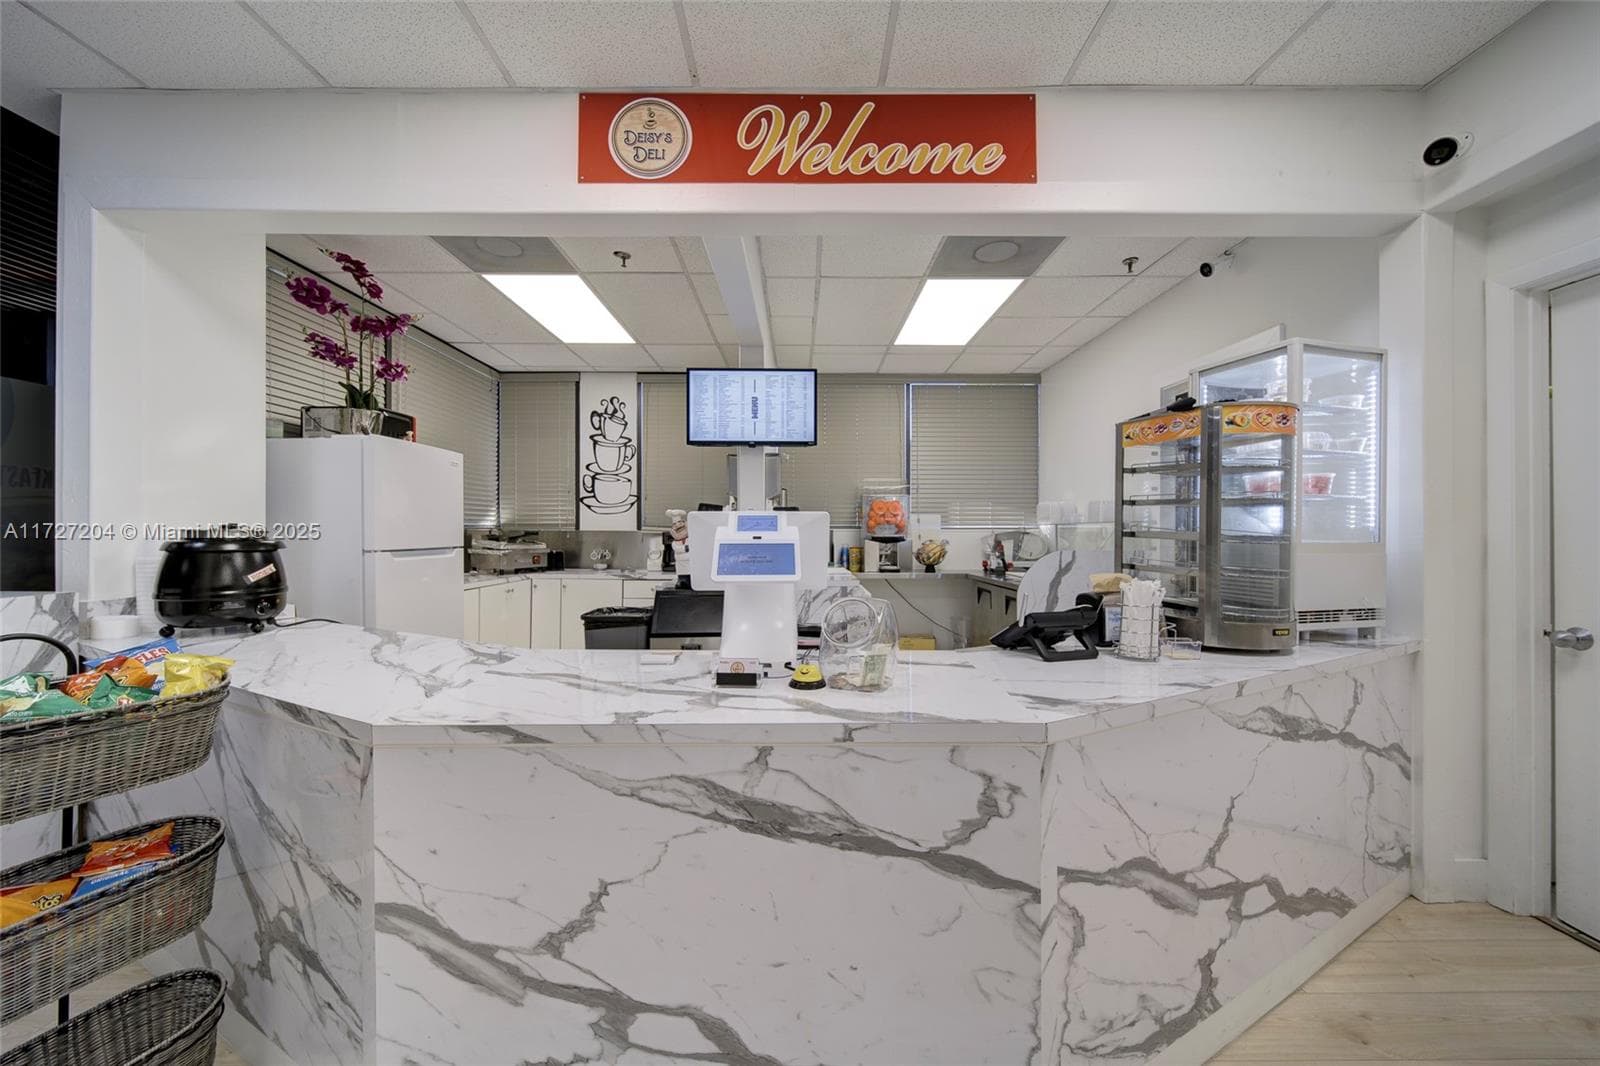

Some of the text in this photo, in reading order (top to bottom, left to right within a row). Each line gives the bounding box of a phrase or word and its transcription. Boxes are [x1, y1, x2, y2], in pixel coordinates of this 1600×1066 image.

[623, 130, 673, 146] DEISY'S
[737, 101, 1007, 176] Welcome
[633, 146, 666, 163] DELI
[751, 396, 759, 419] MENU
